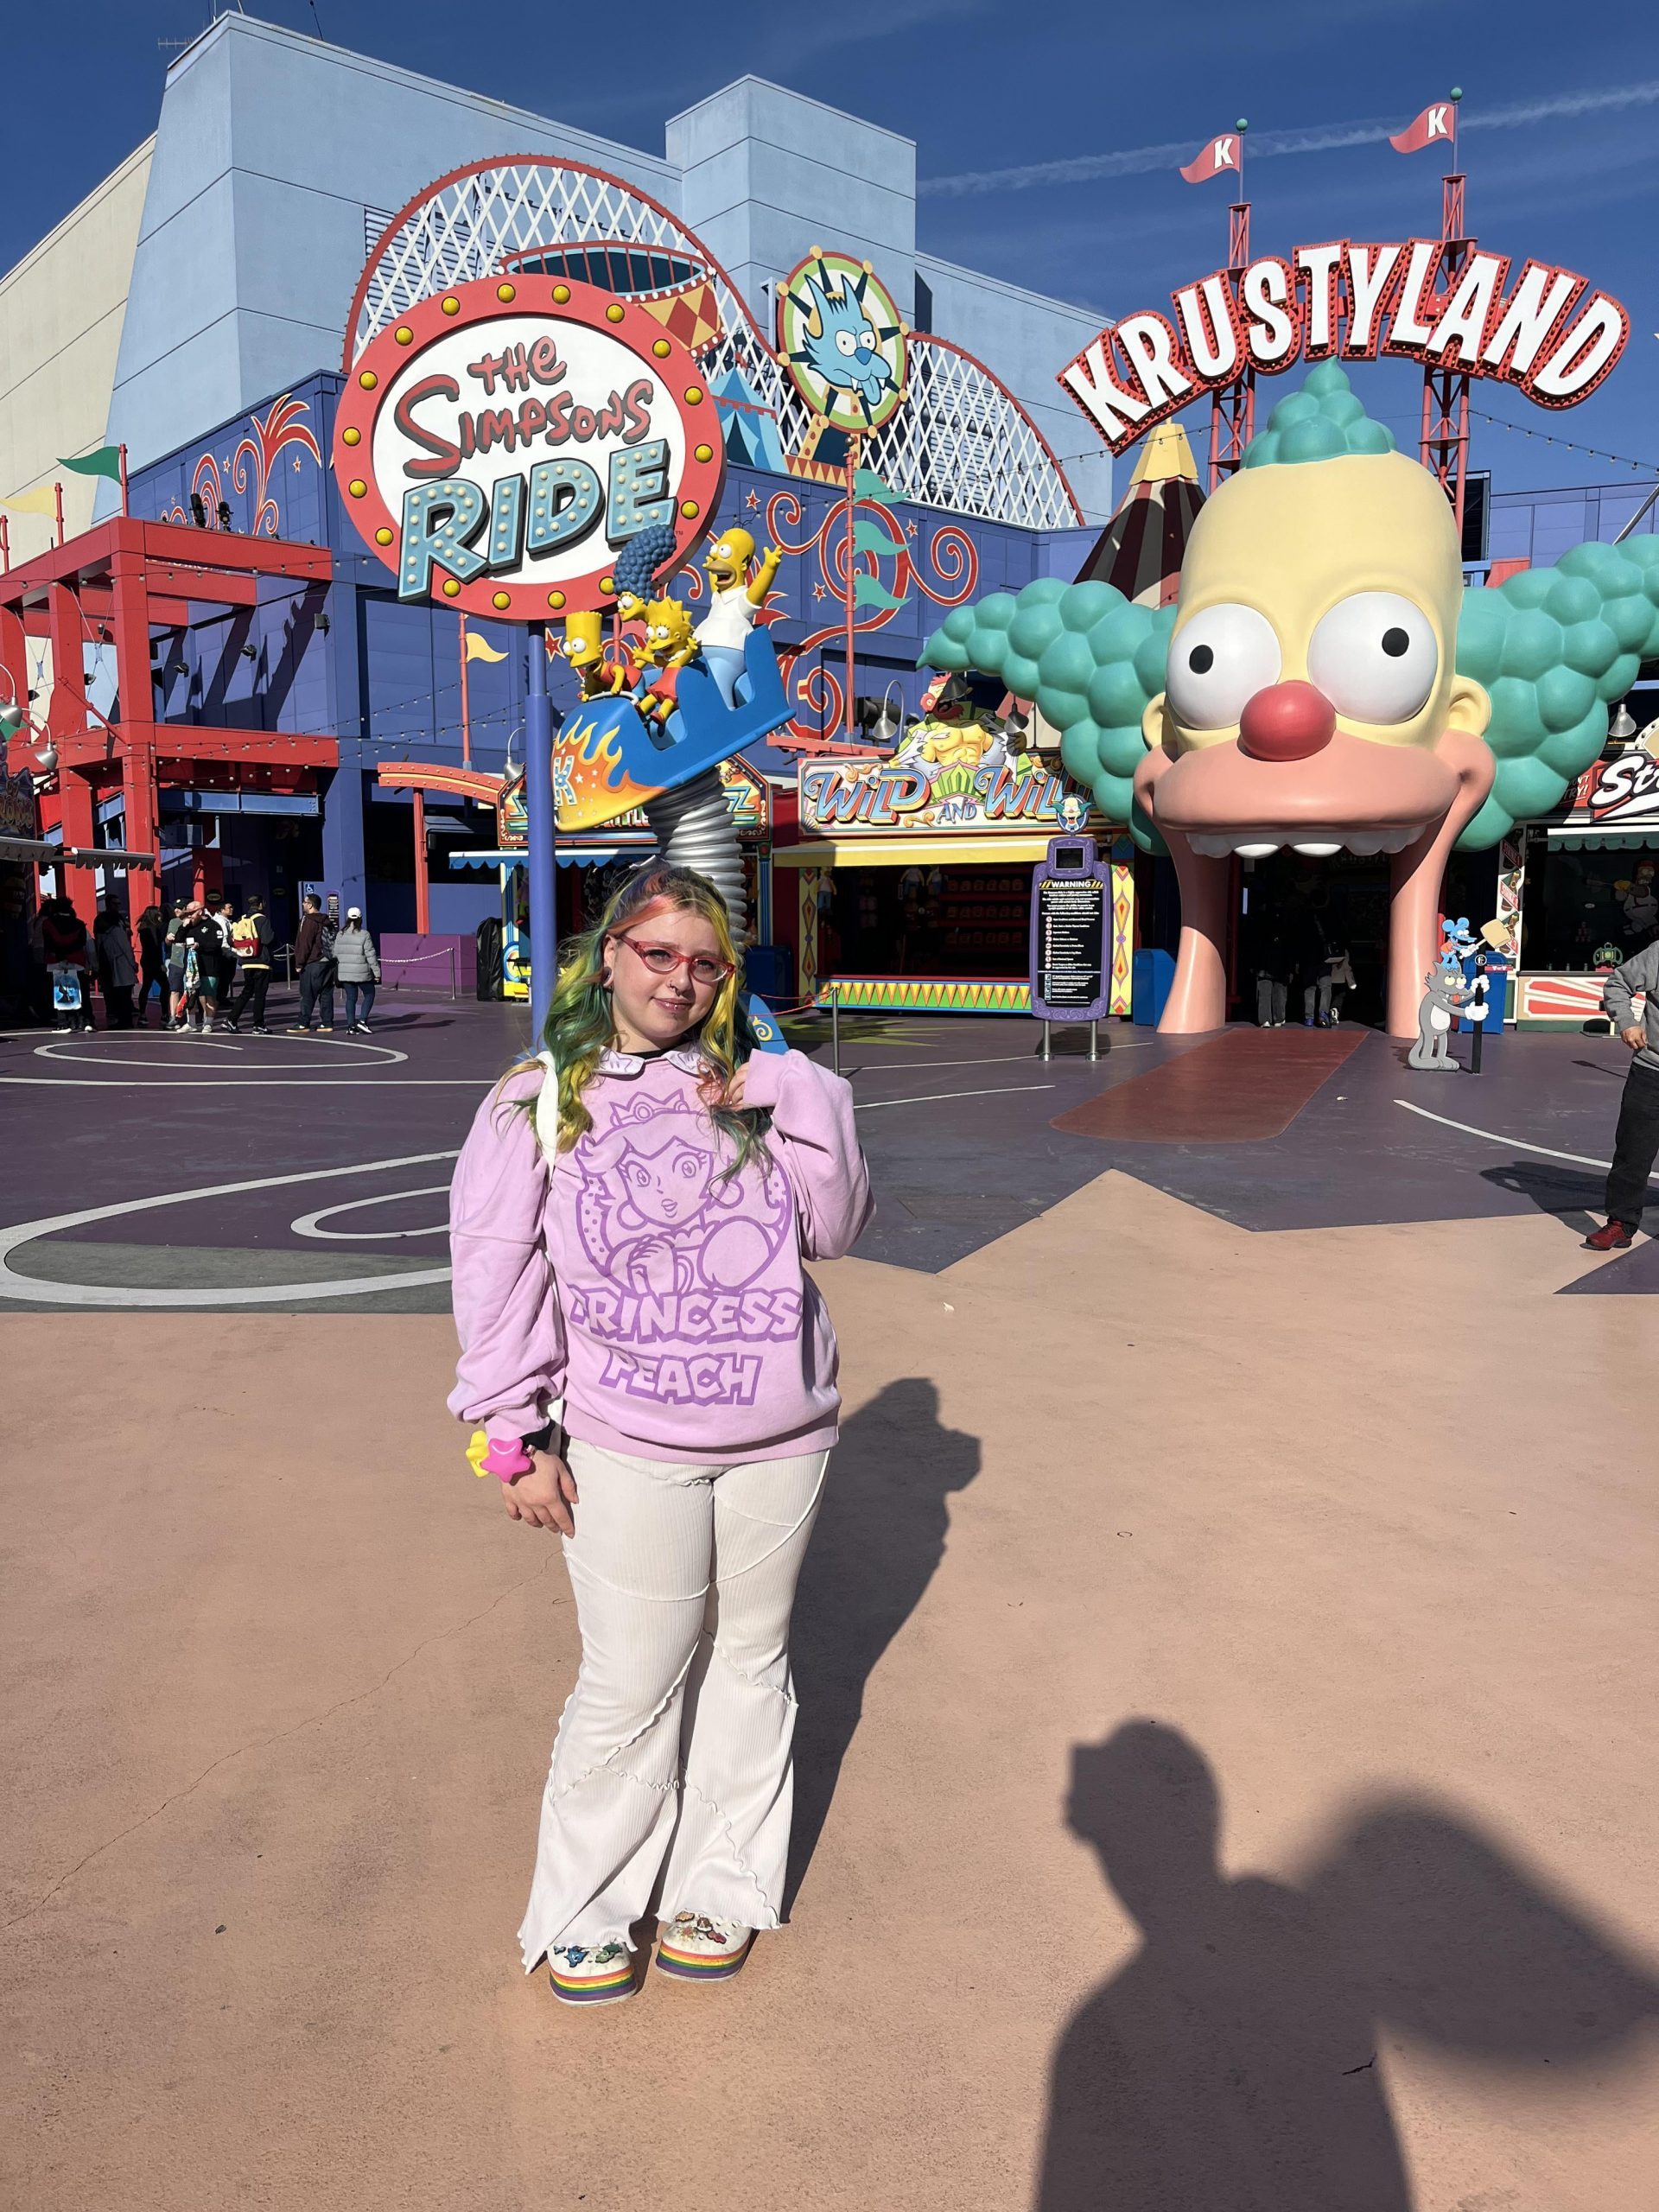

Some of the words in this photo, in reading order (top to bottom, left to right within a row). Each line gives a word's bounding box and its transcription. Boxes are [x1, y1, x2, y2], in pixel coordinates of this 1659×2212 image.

[1427, 106, 1451, 139] K
[1212, 137, 1235, 169] K
[1061, 241, 1626, 448] KRUSTYLAND
[397, 439, 678, 601] RIDE
[1590, 754, 1659, 807] St
[937, 799, 977, 823] AND
[600, 1346, 763, 1407] PEACH
